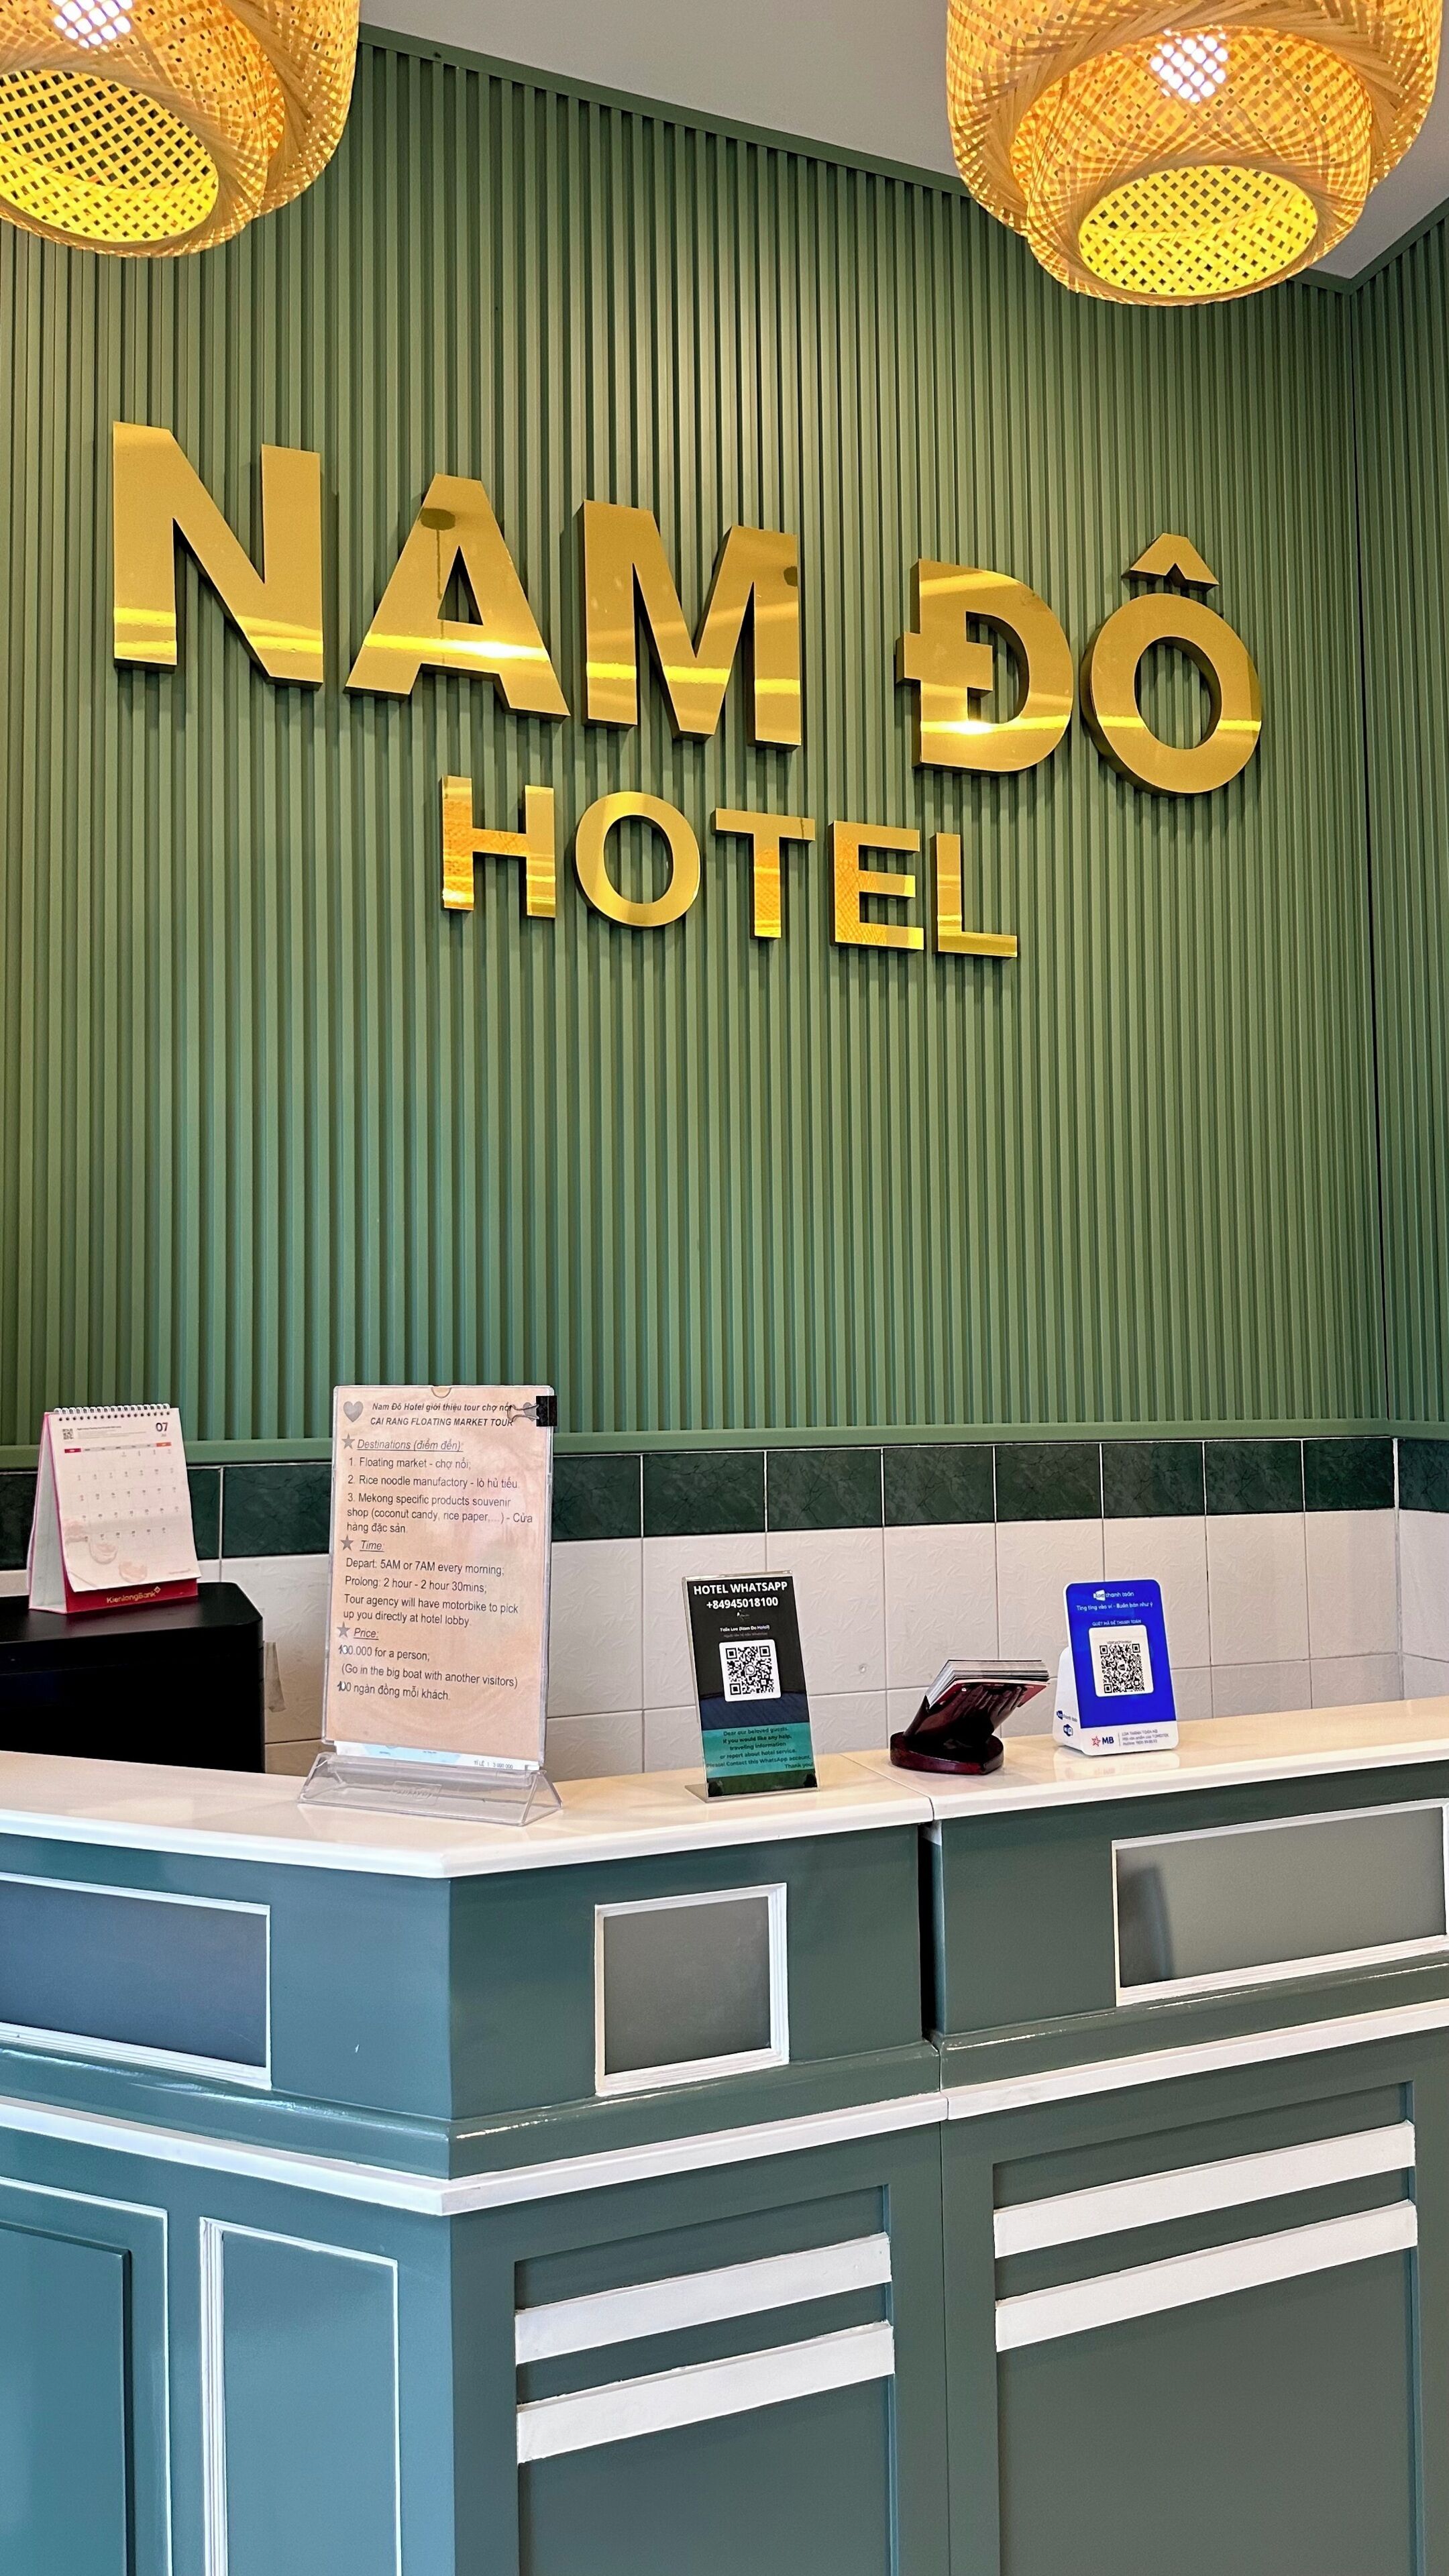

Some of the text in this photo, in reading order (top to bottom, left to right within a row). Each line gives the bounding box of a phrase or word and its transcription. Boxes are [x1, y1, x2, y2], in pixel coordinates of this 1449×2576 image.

[111, 420, 1263, 799] NAM ĐÔ
[441, 775, 1018, 959] HOTEL
[372, 1402, 390, 1411] Nam
[403, 1403, 425, 1411] Hotel
[442, 1403, 462, 1412] thiệu
[464, 1404, 481, 1412] tour
[482, 1403, 498, 1413] chợ
[155, 1421, 168, 1433] 07
[411, 1417, 452, 1426] FLOATING
[453, 1418, 490, 1427] MARKET
[490, 1419, 513, 1427] TOUR
[357, 1439, 411, 1450] Destinations
[359, 1457, 394, 1470] Floating
[396, 1458, 427, 1468] market
[435, 1459, 453, 1470] chợ
[359, 1474, 379, 1485] Rice
[380, 1475, 411, 1486] noodle
[413, 1477, 468, 1490] manufactory
[358, 1493, 394, 1505] Mekong
[396, 1495, 429, 1505] specific
[431, 1495, 470, 1507] products
[472, 1497, 512, 1507] souvenir
[347, 1507, 369, 1519] shop
[371, 1507, 410, 1520] (coconut
[443, 1511, 460, 1521] rice
[371, 1523, 388, 1534] đặc
[346, 1558, 505, 1578] Depart: 5AM or 7AM every morning;
[384, 1577, 390, 1588] 2
[392, 1578, 413, 1589] hour
[421, 1579, 427, 1589] 2
[429, 1580, 450, 1591] hour
[693, 1581, 788, 1595] HOTEL WHATSAPP
[106, 1590, 156, 1604] KienlongBank
[344, 1593, 519, 1615] Tour agency will have motorbike to pick
[706, 1597, 779, 1609] +84945018100
[343, 1611, 472, 1629] up you directly at hotel lobby.
[354, 1627, 380, 1638] Price:
[374, 1646, 388, 1658] for
[389, 1650, 394, 1658] a
[397, 1650, 431, 1662] person;
[341, 1664, 519, 1690] (Go in the big boat with another visitors)
[1102, 1736, 1114, 1745] MB
